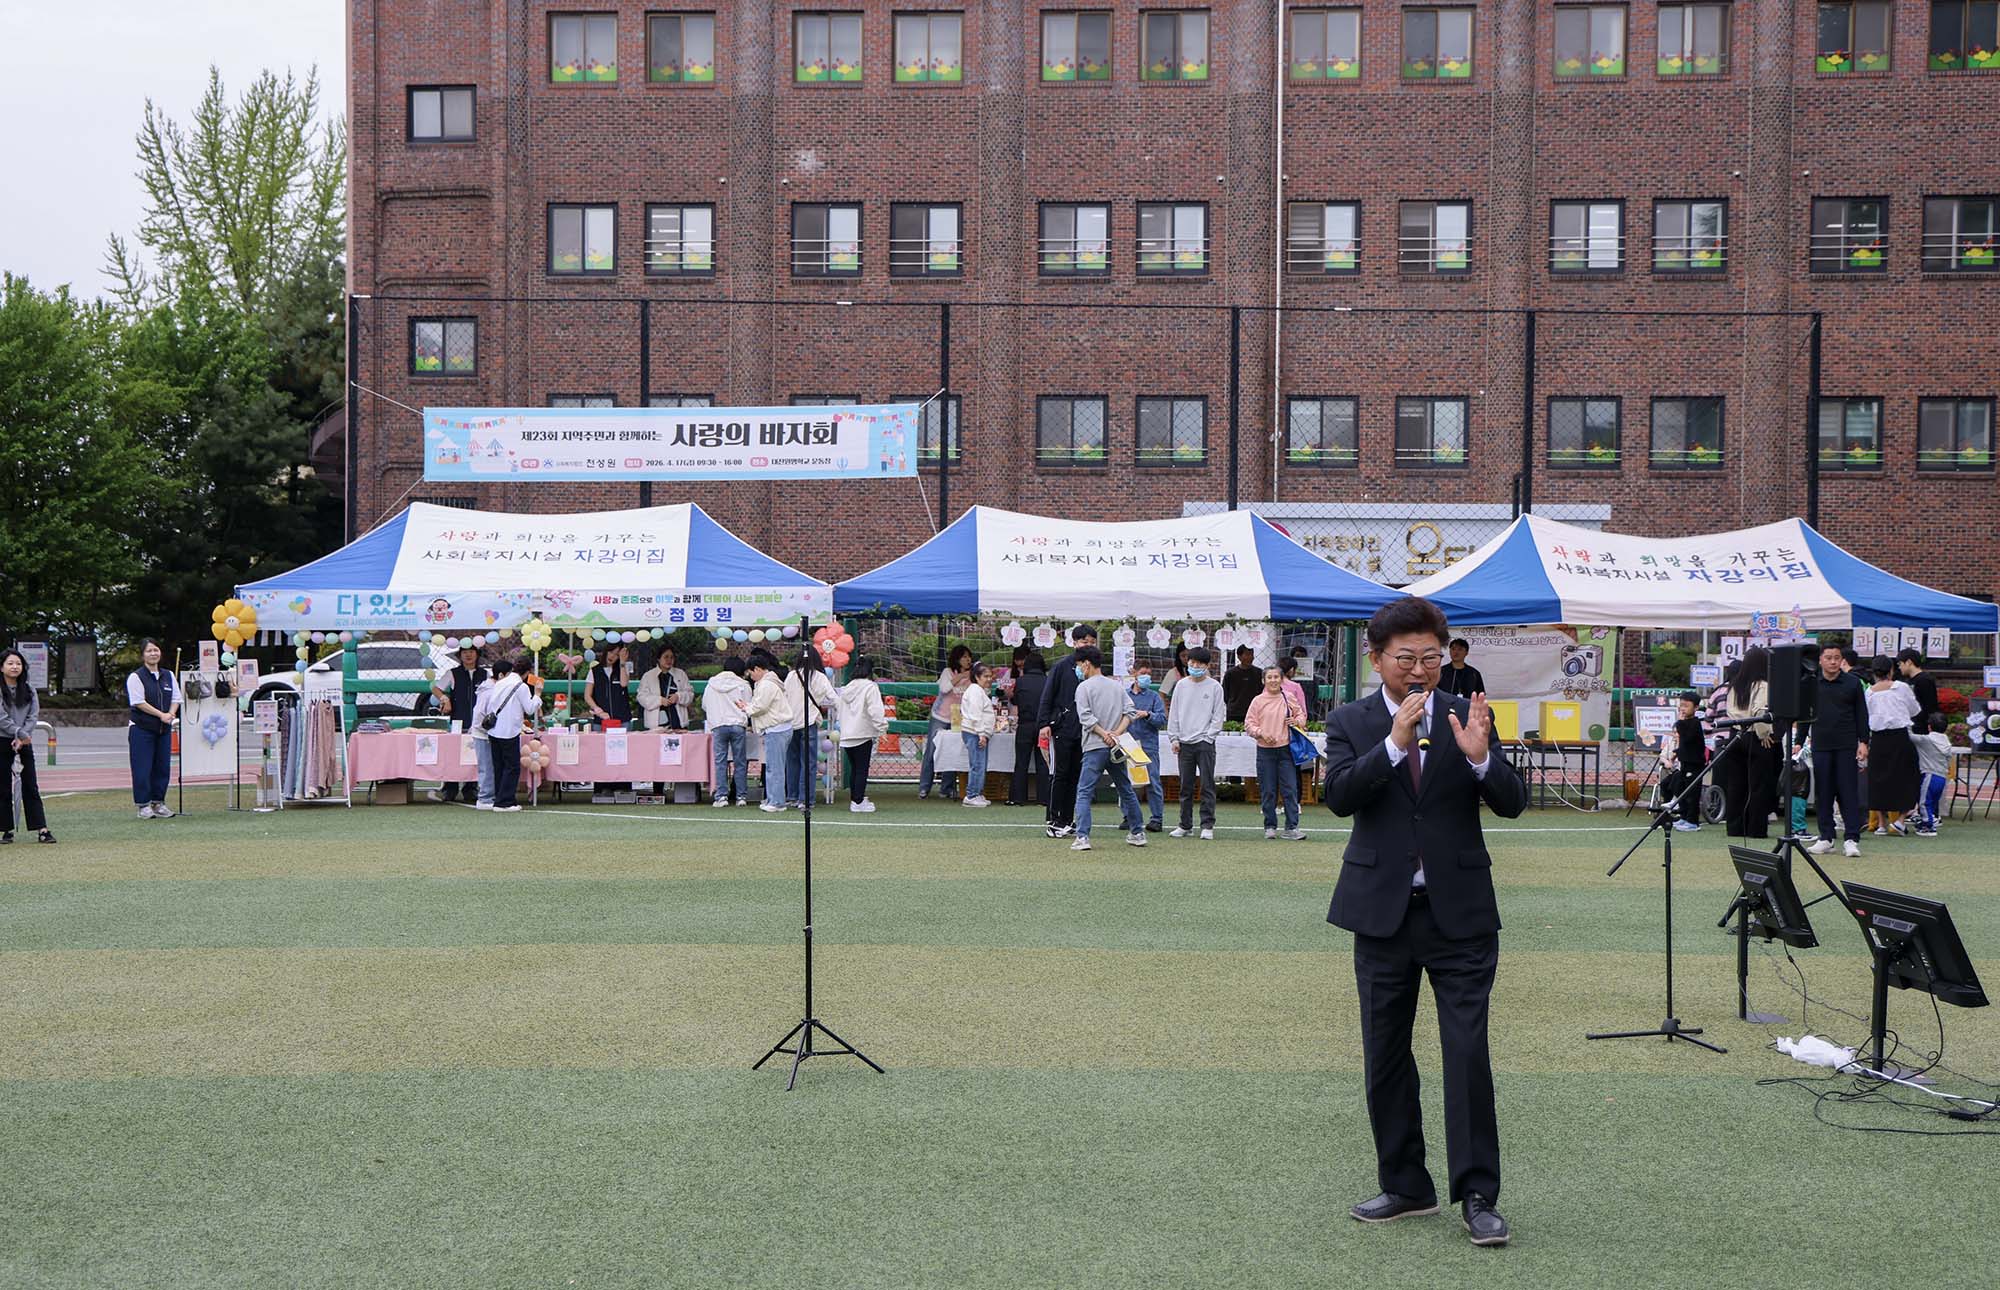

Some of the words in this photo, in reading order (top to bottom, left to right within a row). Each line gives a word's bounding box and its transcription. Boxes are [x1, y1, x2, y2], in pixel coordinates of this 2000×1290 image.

[521, 430, 558, 442] 제23회
[561, 430, 615, 442] 지역주민과
[619, 430, 663, 442] 함께하는
[670, 422, 750, 447] 사랑의
[760, 421, 838, 446] 바자회
[586, 458, 616, 469] 천성원
[697, 458, 717, 466] 09:30
[724, 458, 743, 466] 16:00
[438, 529, 501, 541] 사랑과
[513, 532, 578, 543] 희망을
[593, 532, 657, 543] 가꾸는
[1009, 536, 1072, 547] 사랑과
[1085, 538, 1147, 549] 희망을
[1160, 536, 1222, 548] 가꾸는
[421, 549, 562, 562] 사회복지시설
[574, 548, 665, 565] 자강의집
[1001, 553, 1138, 566] 사회복지시설
[1148, 552, 1238, 569] 자강의집
[1552, 545, 1617, 565] 사랑과
[1640, 553, 1706, 568] 희망을
[1729, 547, 1796, 567] 가꾸는
[1556, 561, 1672, 581] 사회복지시설
[1683, 561, 1813, 584] 자강의집
[592, 595, 618, 604] 사랑과
[620, 595, 652, 604] 존중으로
[655, 594, 681, 604] 이웃과
[682, 594, 701, 604] 함께
[703, 593, 732, 603] 더불어
[669, 607, 732, 622] 정화원
[1855, 633, 1944, 655] 과일모찌
